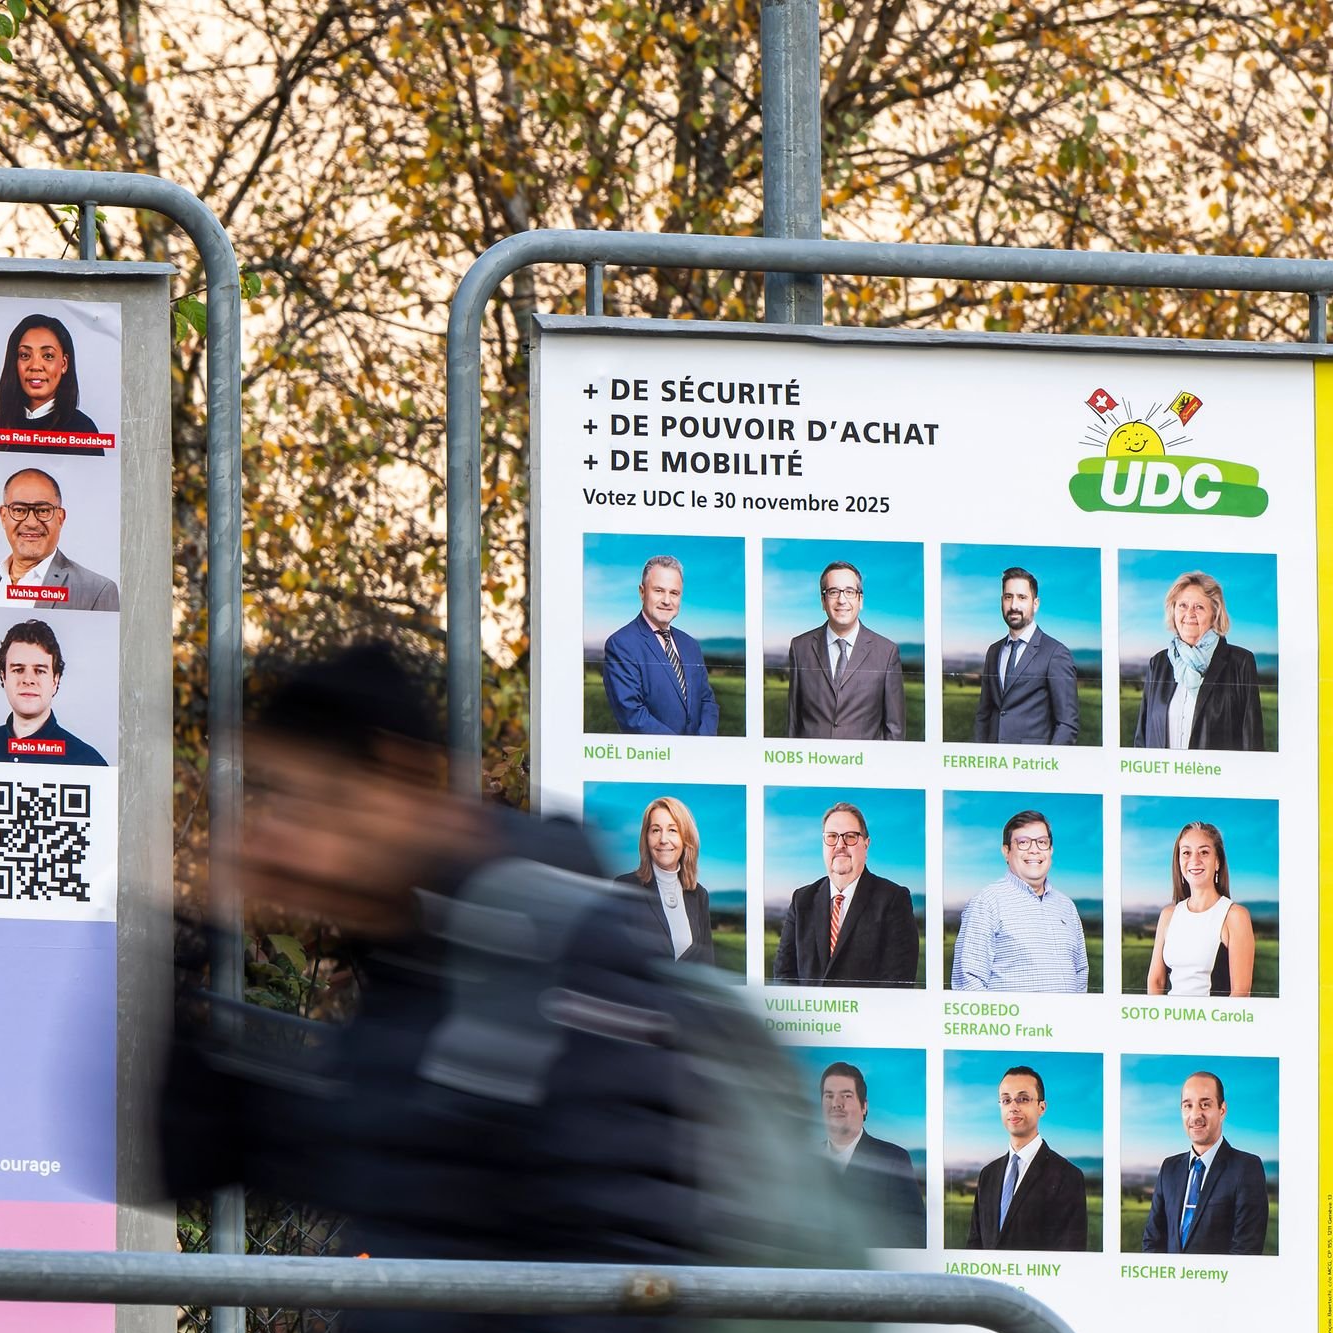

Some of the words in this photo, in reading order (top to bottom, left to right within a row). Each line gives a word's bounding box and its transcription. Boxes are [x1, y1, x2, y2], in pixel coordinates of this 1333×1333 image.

[611, 378, 649, 401] DE
[661, 375, 801, 405] SÉCURITÉ
[611, 414, 649, 437] DE
[661, 416, 795, 441] POUVOIR
[808, 419, 939, 445] D'ACHAT
[611, 450, 649, 472] DE
[661, 447, 803, 477] MOBILITÉ
[1100, 459, 1224, 510] UDC
[583, 488, 636, 508] Votez
[643, 490, 684, 508] UDC
[691, 491, 708, 509] le
[713, 492, 736, 510] 30
[742, 493, 839, 512] novembre
[845, 496, 890, 513] 2025
[583, 743, 622, 761] NOËL
[626, 745, 671, 761] Daniel
[764, 749, 804, 765] NOBS
[808, 750, 863, 767] Howard
[943, 754, 1007, 770] FERREIRA
[1012, 756, 1059, 773] Patrick
[1120, 759, 1169, 775] PIGUET
[1174, 759, 1221, 776] Hélène
[765, 999, 859, 1014] VUILLEUMIER
[944, 1002, 1019, 1017] ESCOBEDO
[1121, 1007, 1158, 1022] SOTO
[1164, 1008, 1207, 1023] PUMA
[1211, 1008, 1254, 1023] Carola
[765, 1019, 841, 1037] Dominique
[944, 1021, 1011, 1037] SERRANO
[1015, 1023, 1053, 1038] Frank
[944, 1261, 1022, 1278] JARDON-EL
[1027, 1262, 1061, 1278] HINY
[1120, 1265, 1176, 1281] FISCHER
[1180, 1266, 1228, 1284] Jeremy
